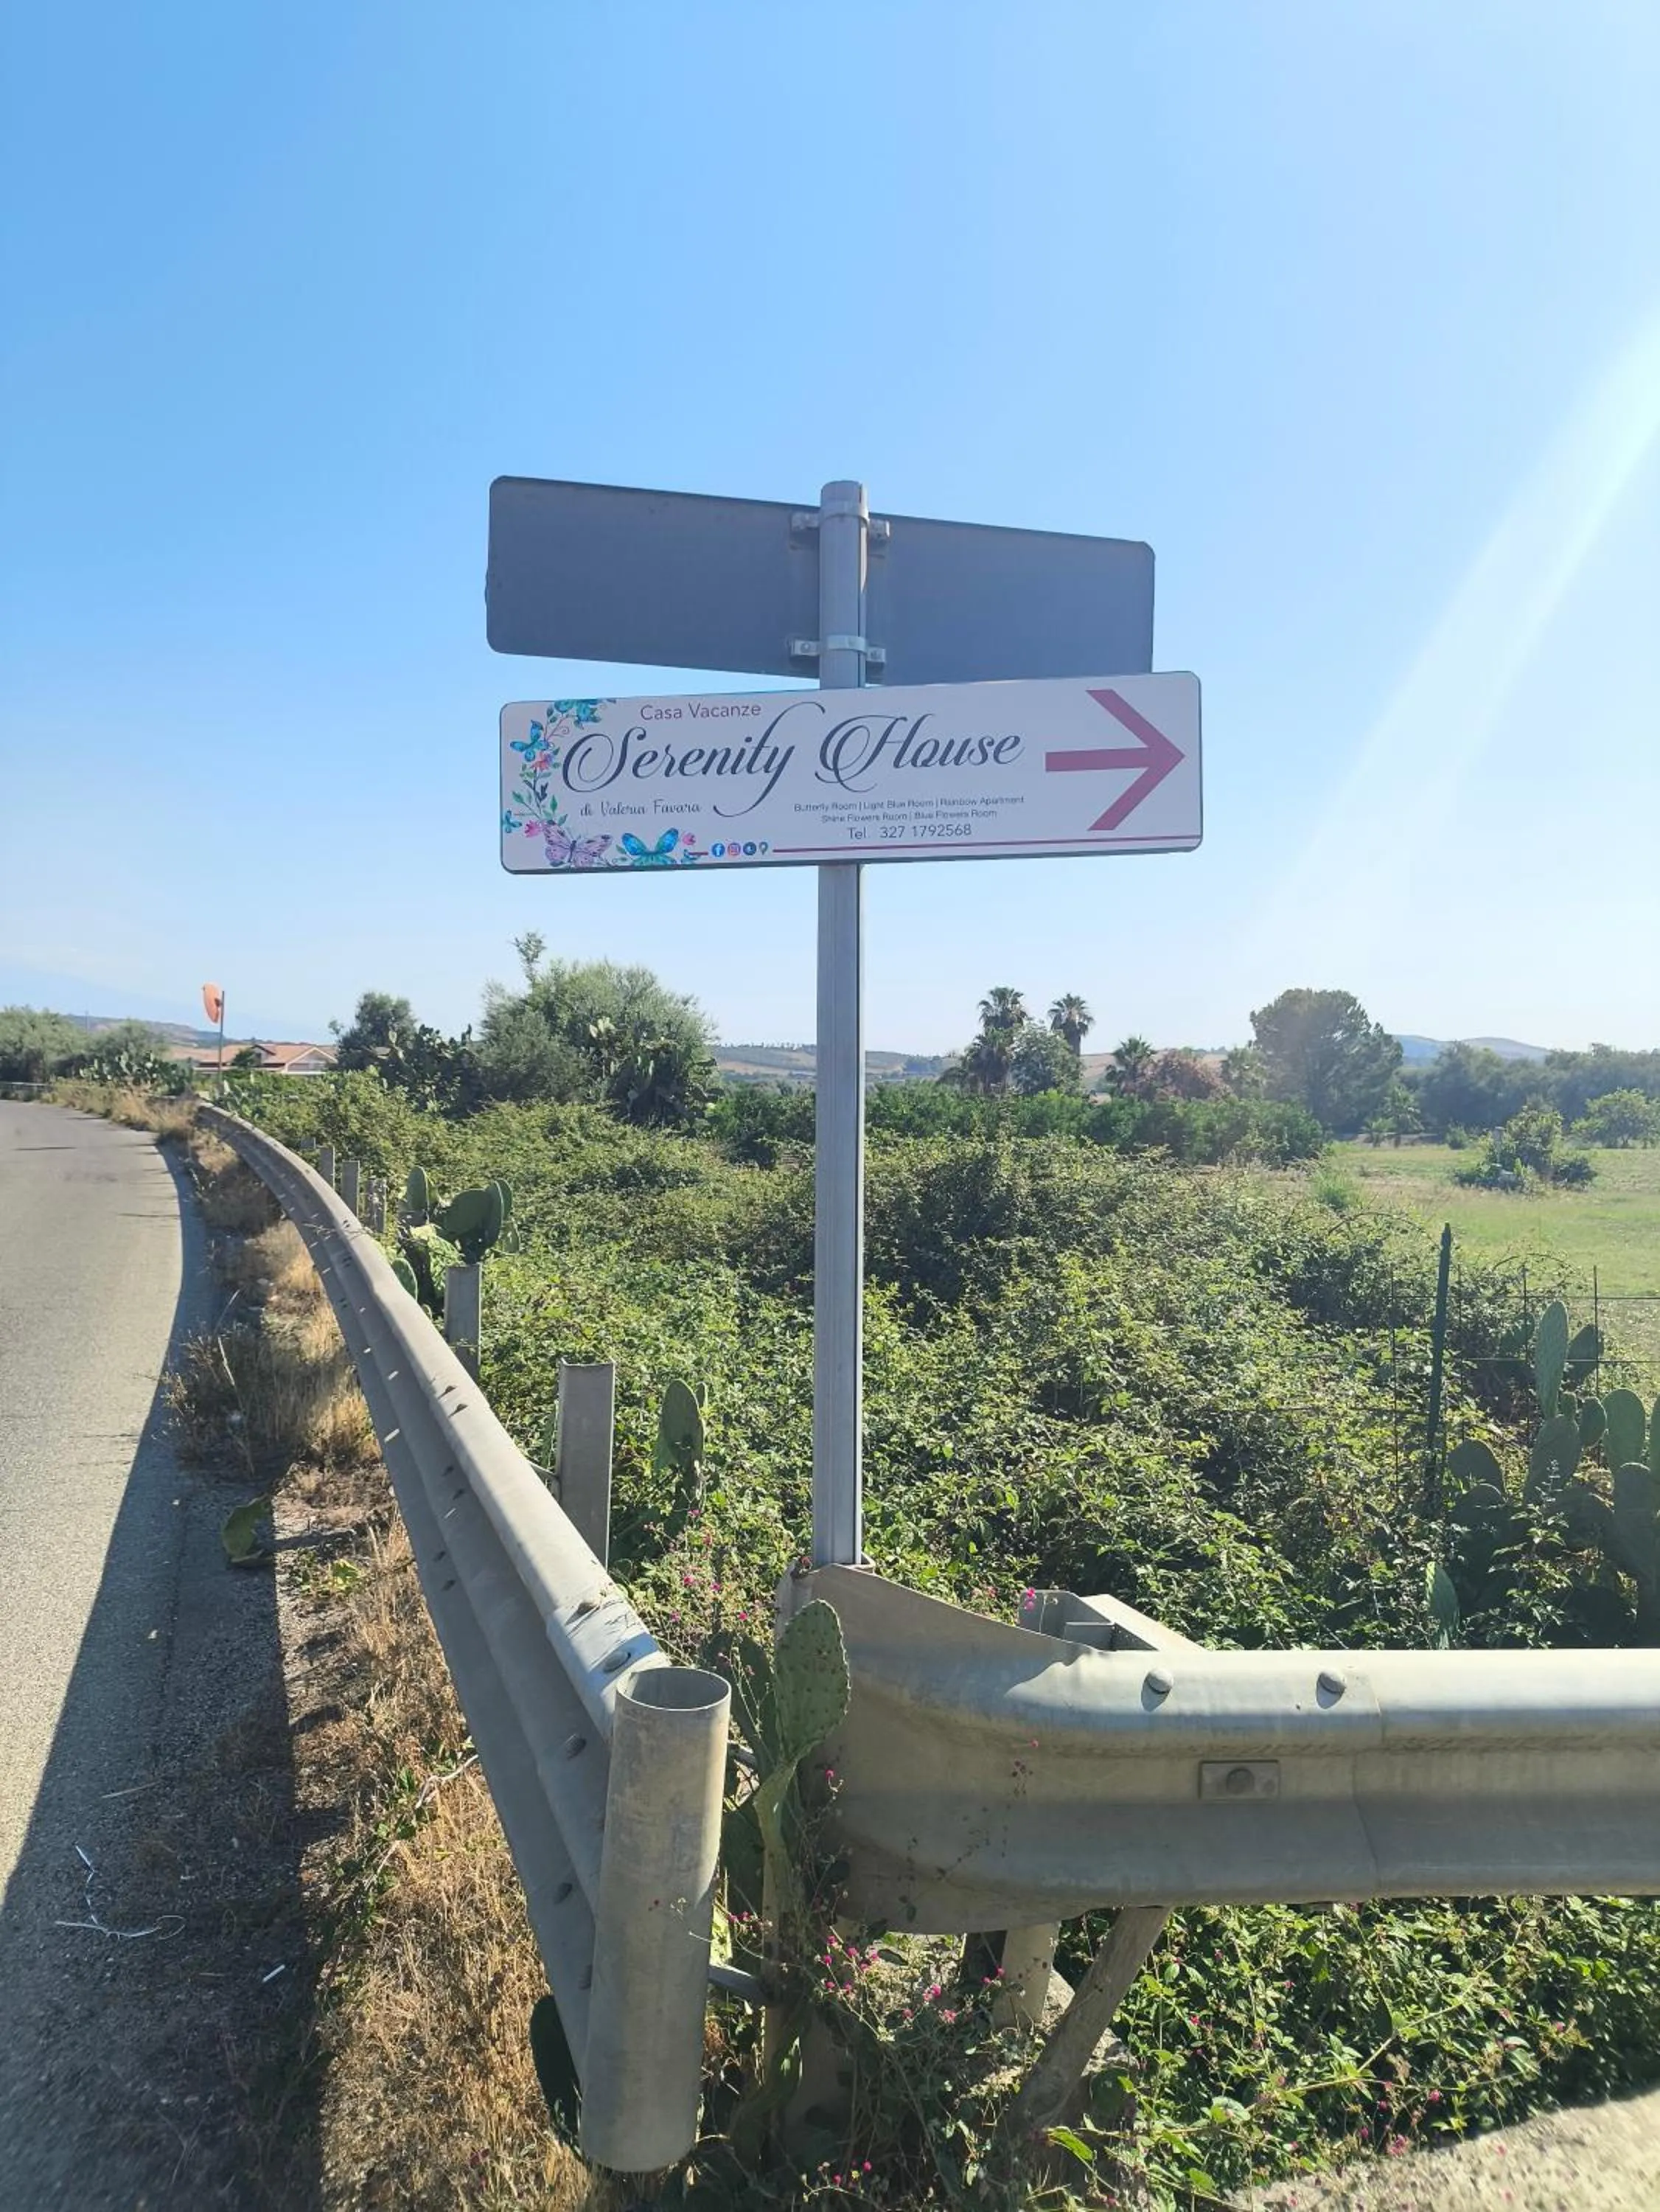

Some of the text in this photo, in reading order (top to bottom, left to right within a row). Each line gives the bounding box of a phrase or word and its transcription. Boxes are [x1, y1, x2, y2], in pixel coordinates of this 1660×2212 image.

[641, 701, 761, 721] Casa Vacanze
[562, 701, 1026, 818] Serenity House
[794, 803, 830, 812] Butterfly
[831, 801, 857, 810] Room
[864, 801, 885, 810] Light
[887, 799, 906, 809] Blue
[908, 798, 934, 808] Room
[940, 797, 977, 807] Rainbow
[980, 796, 1025, 806] Apartment
[847, 813, 880, 822] Flowers
[882, 812, 908, 821] Room
[914, 810, 934, 820] Blue
[935, 810, 969, 819] Flowers
[971, 809, 998, 818] Room
[879, 825, 906, 839] 327
[912, 823, 972, 838] 1792568
